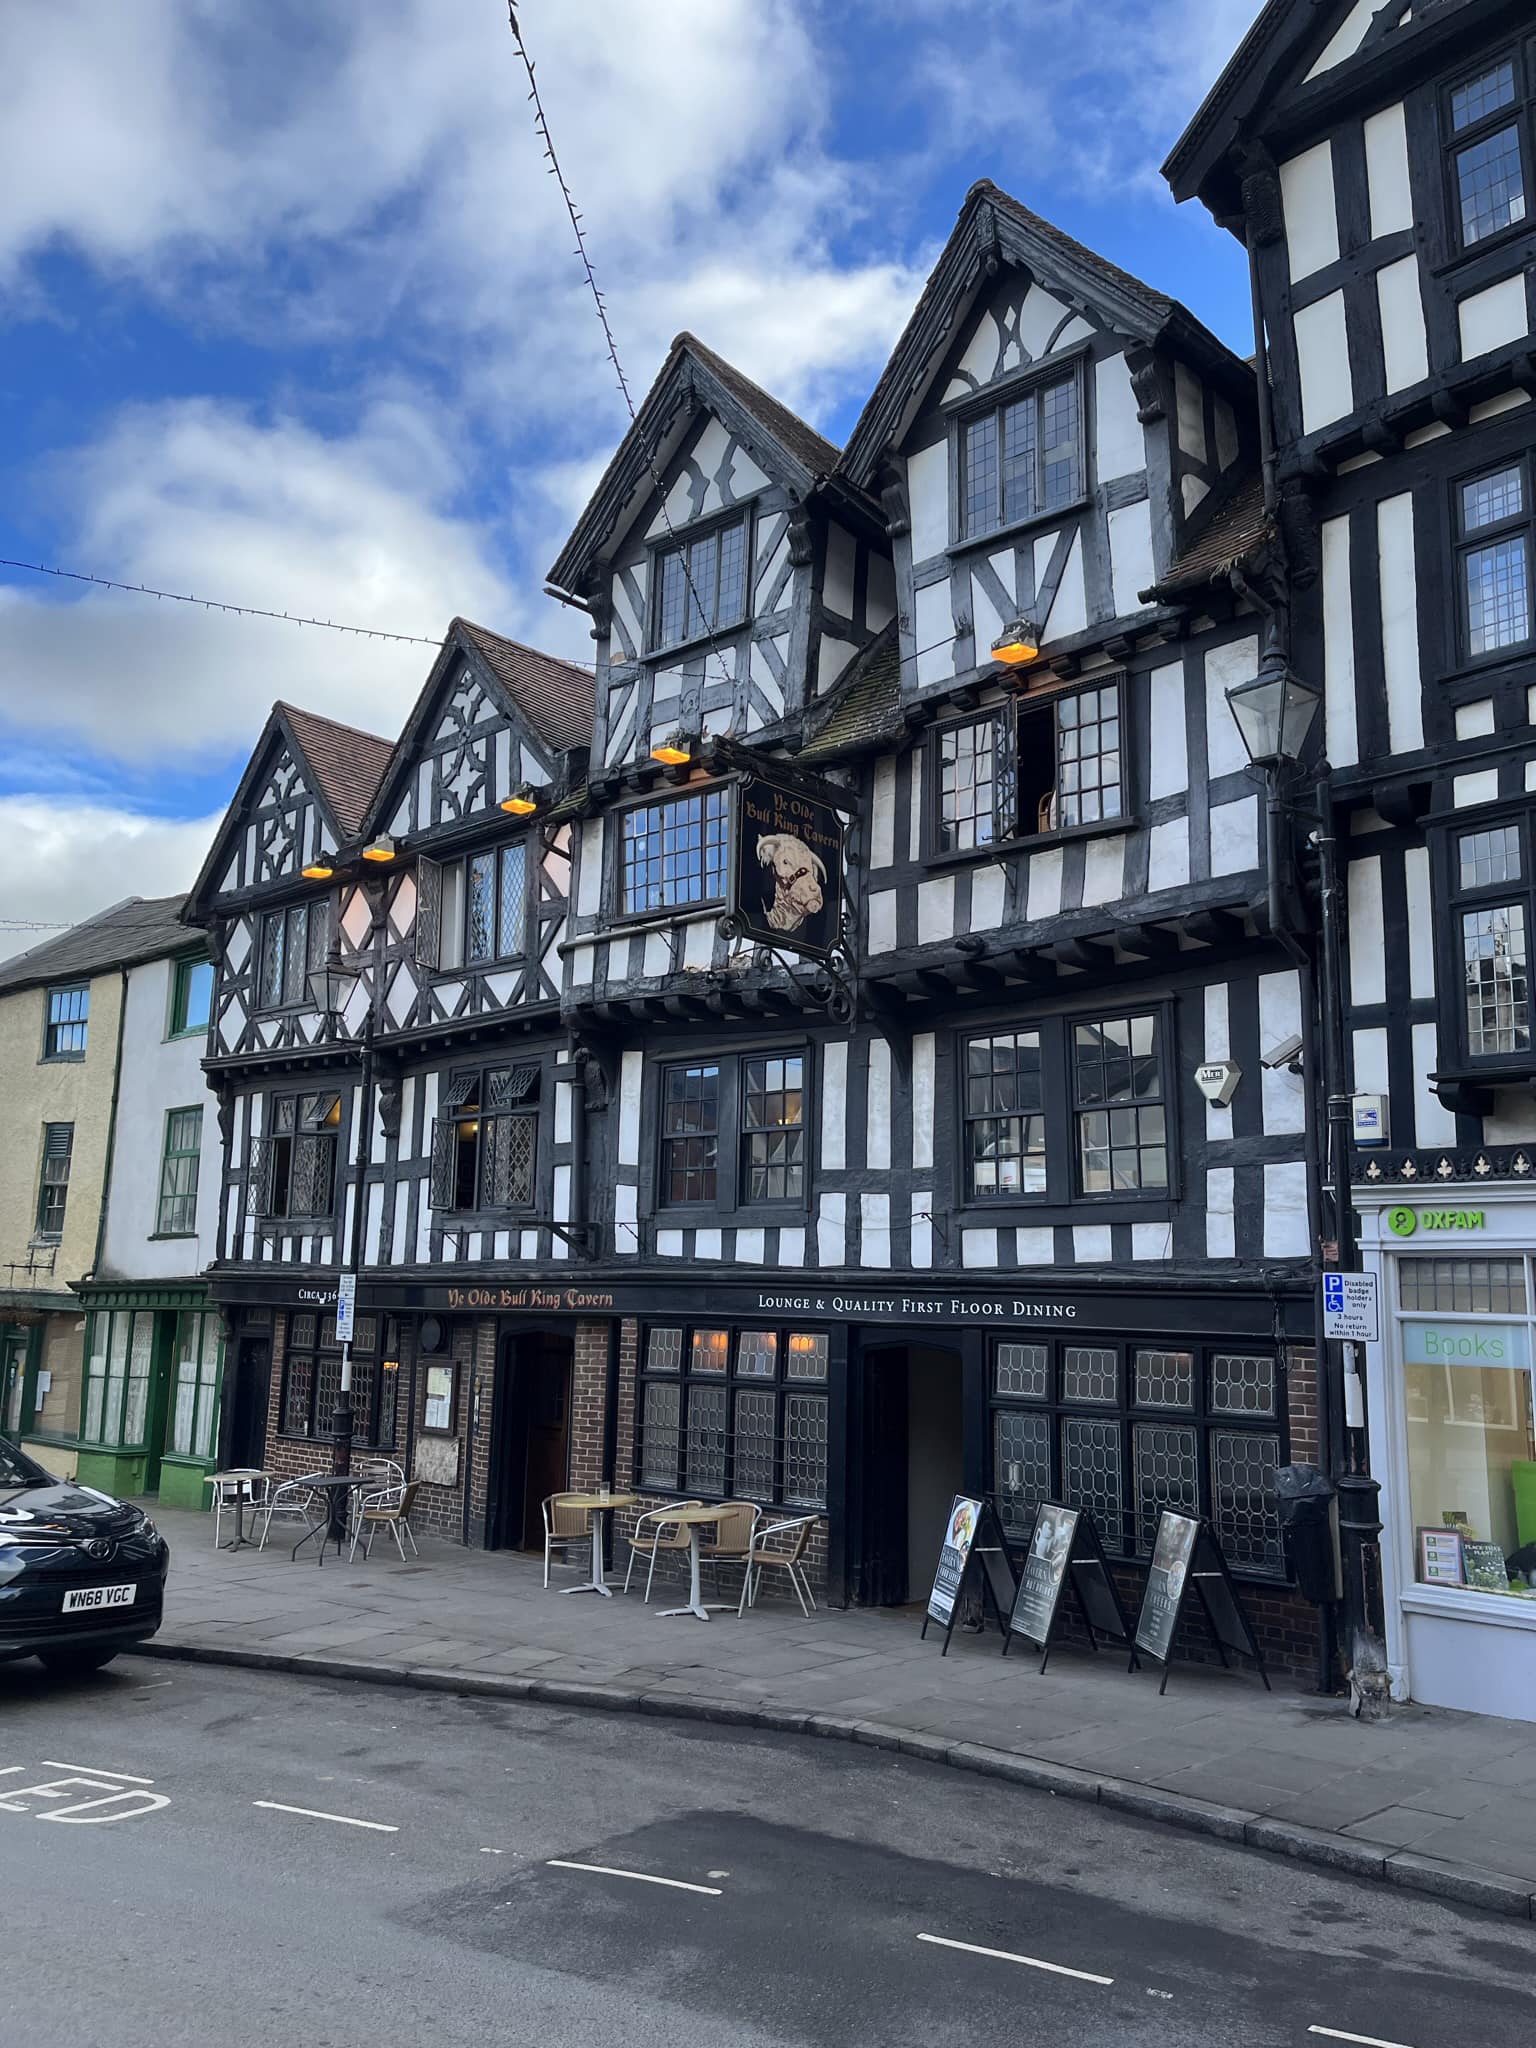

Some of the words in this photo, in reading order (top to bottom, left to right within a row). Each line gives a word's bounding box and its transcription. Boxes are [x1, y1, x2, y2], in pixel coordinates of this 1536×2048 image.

[790, 800, 815, 820] Olde
[746, 800, 771, 824] Bull
[773, 811, 799, 837] Ring
[802, 823, 839, 849] Tavern
[1420, 1210, 1485, 1230] OXFAM
[1329, 1276, 1340, 1291] P
[1344, 1280, 1374, 1288] Disabled
[323, 1289, 339, 1302] 136
[467, 1288, 497, 1305] Olde
[499, 1288, 527, 1306] Bull
[530, 1288, 561, 1309] Ring
[564, 1287, 613, 1309] Tavern
[815, 1299, 825, 1310] &
[1344, 1313, 1363, 1321] hours
[1424, 1330, 1505, 1359] Books
[69, 1590, 103, 1609] WN68
[106, 1586, 131, 1604] VGC
